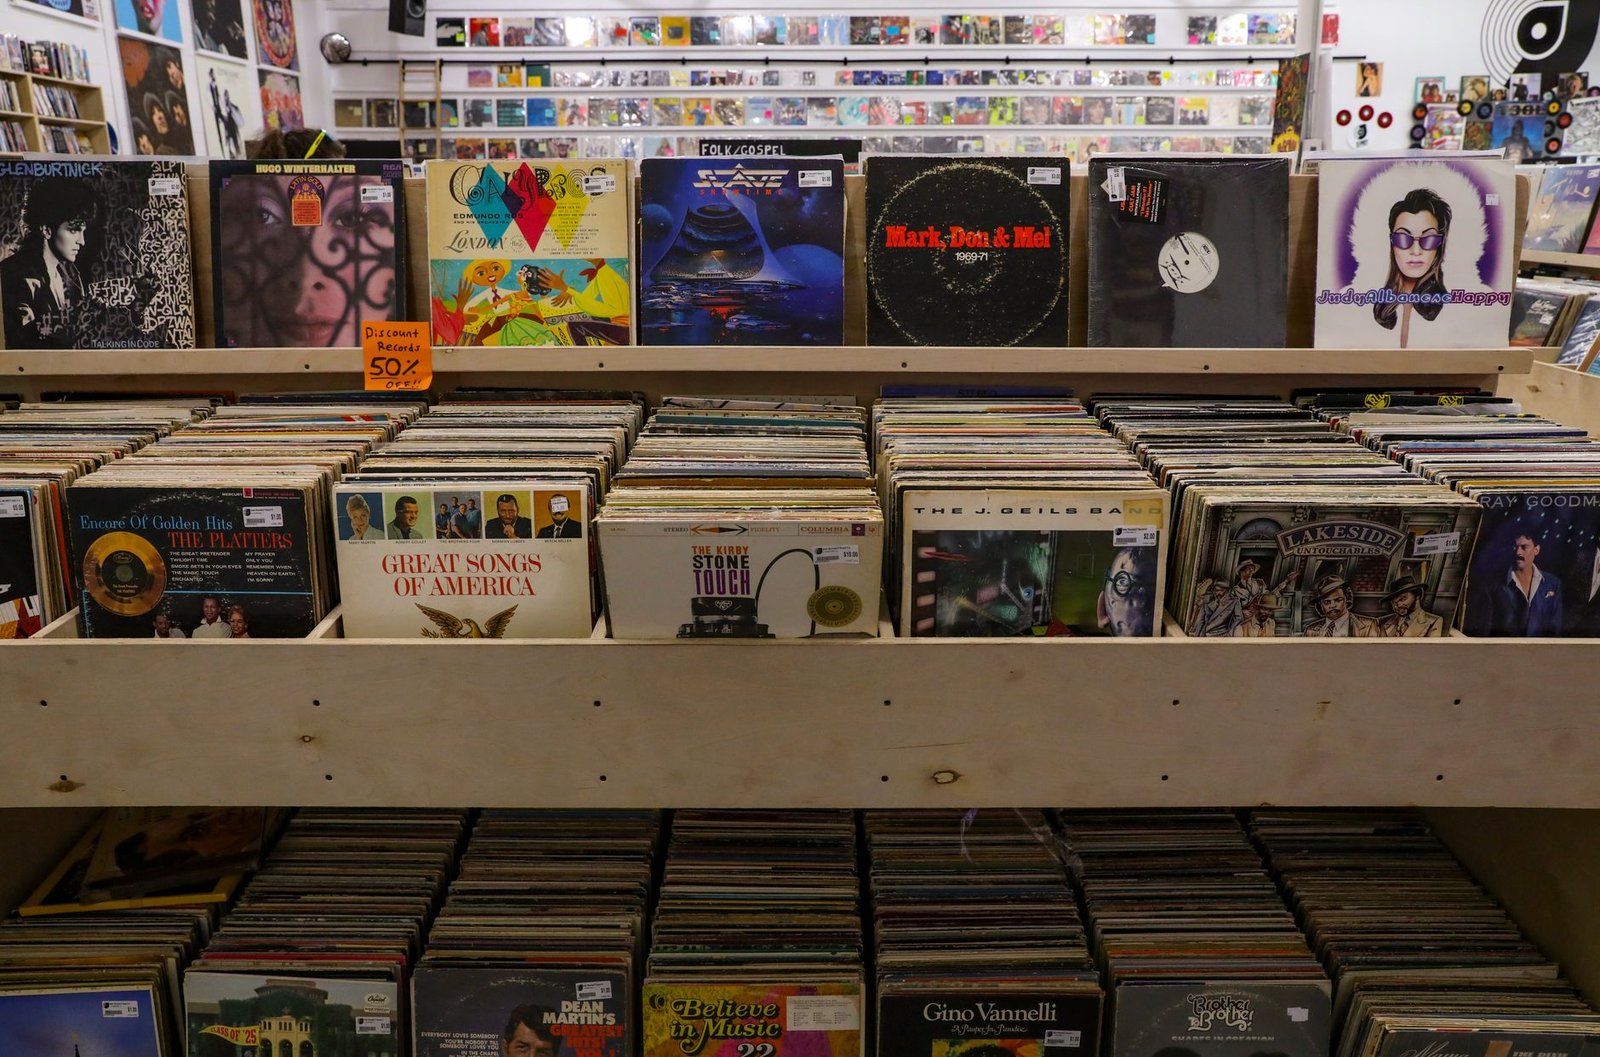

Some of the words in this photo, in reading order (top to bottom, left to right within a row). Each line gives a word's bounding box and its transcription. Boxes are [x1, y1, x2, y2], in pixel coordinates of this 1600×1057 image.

[701, 143, 786, 156] FOLK/GOSPEL
[256, 164, 282, 173] HUGO
[283, 164, 356, 173] WINTERHALTER
[693, 163, 789, 188] SLAVE
[290, 176, 307, 190] LATIN
[307, 177, 323, 191] GOLD
[885, 225, 946, 252] Mark,
[949, 225, 990, 248] Don
[993, 226, 1010, 248] &
[1013, 225, 1052, 249] Mel
[955, 252, 989, 261] 1969-71
[365, 326, 420, 339] Discount
[377, 341, 420, 352] Records
[369, 356, 420, 376] 50%
[1480, 495, 1516, 508] RAY
[914, 507, 963, 515] THE
[975, 507, 991, 515] J.
[1000, 507, 1078, 515] GEILS
[1090, 507, 1162, 515] BAND
[80, 515, 126, 530] Encore
[130, 514, 150, 530] Of
[152, 514, 200, 530] Golden
[205, 515, 233, 530] Hits
[167, 532, 204, 549] THE
[210, 532, 293, 549] PLATTERS
[1286, 525, 1396, 549] LAKESIDE
[1445, 538, 1459, 548] $1.00
[691, 545, 713, 555] THE
[716, 545, 749, 555] KIRBY
[1297, 546, 1383, 556] UNTOUCHABLES
[381, 553, 460, 575] GREAT
[466, 553, 542, 574] SONGS
[692, 555, 750, 569] STONE
[394, 577, 425, 597] OF
[429, 576, 536, 596] AMERICA
[693, 569, 750, 596] TOUCH
[561, 1000, 604, 1013] DEAN
[670, 999, 778, 1018] Believe
[923, 1002, 974, 1022] Gino
[975, 1002, 1057, 1022] Vannelli
[1187, 993, 1251, 1016] Brother
[543, 1012, 616, 1025] MARTIN'S
[210, 1026, 229, 1038] CLASS
[230, 1029, 240, 1042] OF
[243, 1029, 257, 1044] '25
[550, 1024, 625, 1037] GREATEST
[671, 1020, 697, 1038] in
[680, 1018, 780, 1053] Music
[737, 1043, 775, 1057] 22
